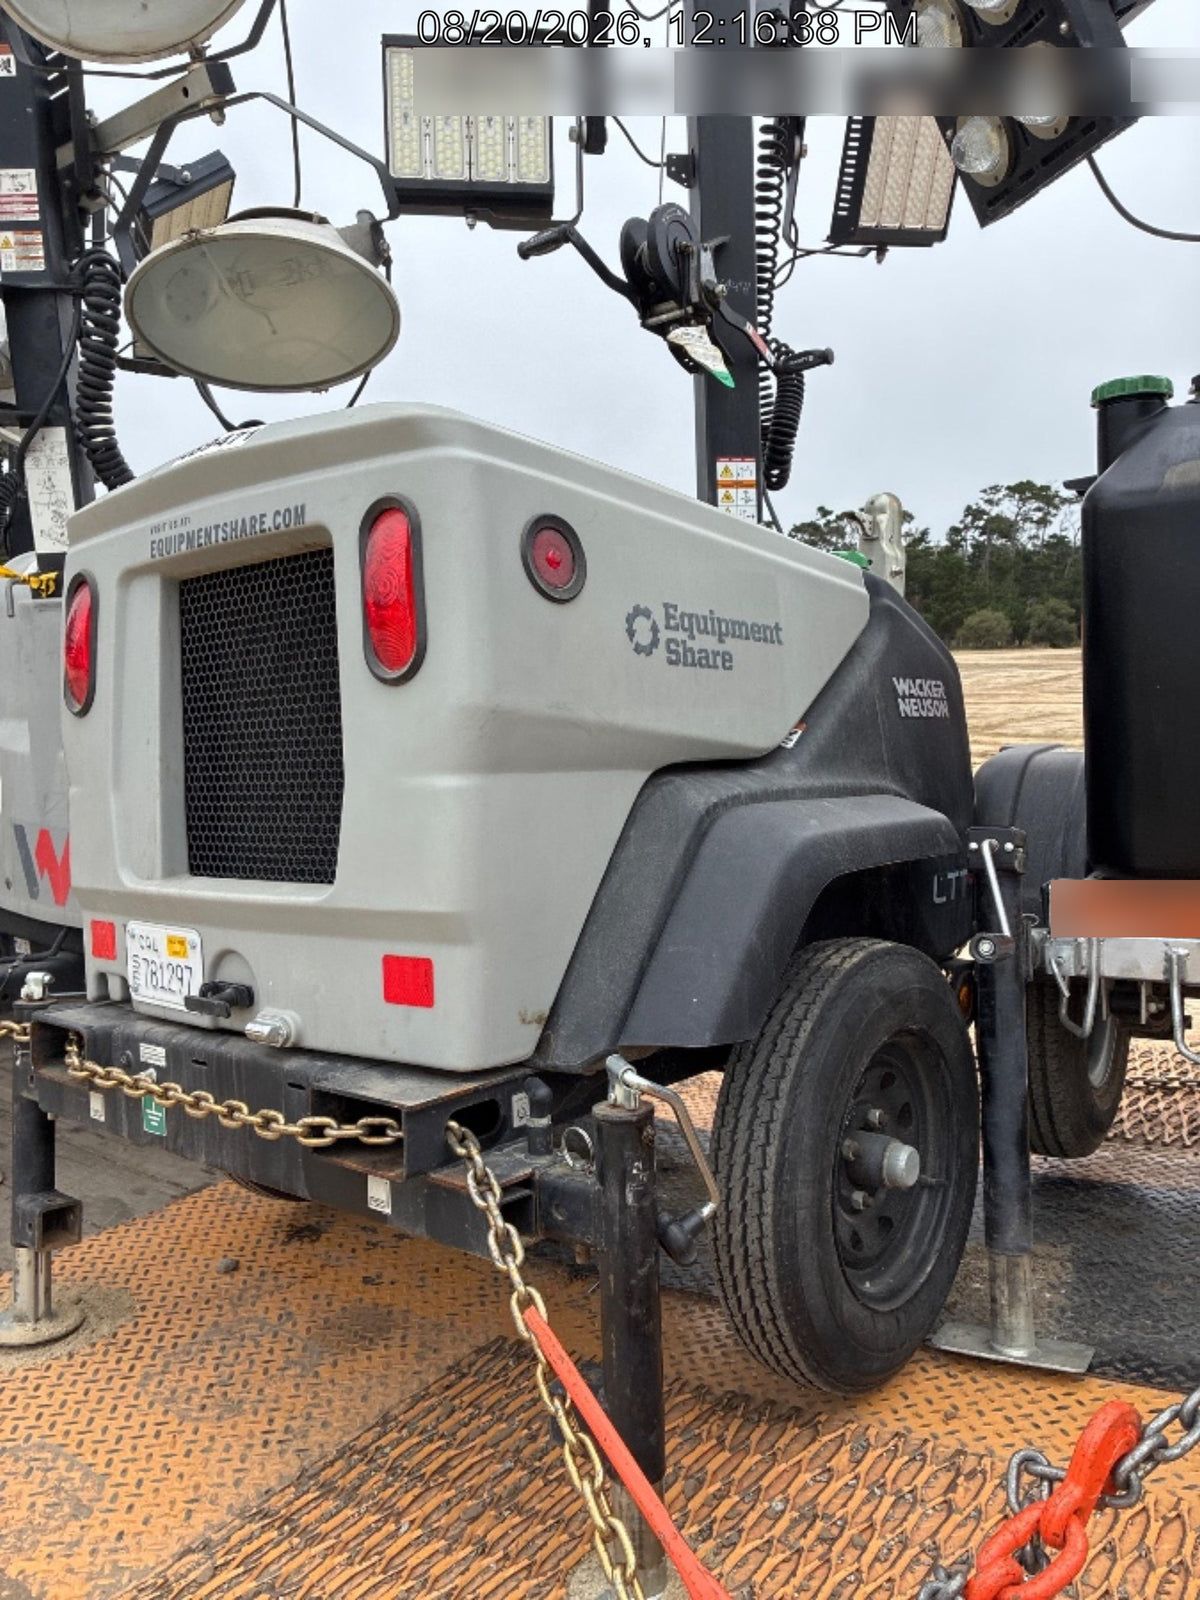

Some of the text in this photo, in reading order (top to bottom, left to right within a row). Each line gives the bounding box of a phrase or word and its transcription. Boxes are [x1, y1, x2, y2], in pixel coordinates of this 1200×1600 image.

[150, 503, 306, 559] EQUIPMENTSHARE.COM
[662, 602, 784, 646] Equipment
[665, 638, 734, 671] Share
[892, 677, 947, 699] WACKER
[897, 698, 949, 718] NEUSON
[142, 957, 193, 997] 781297
